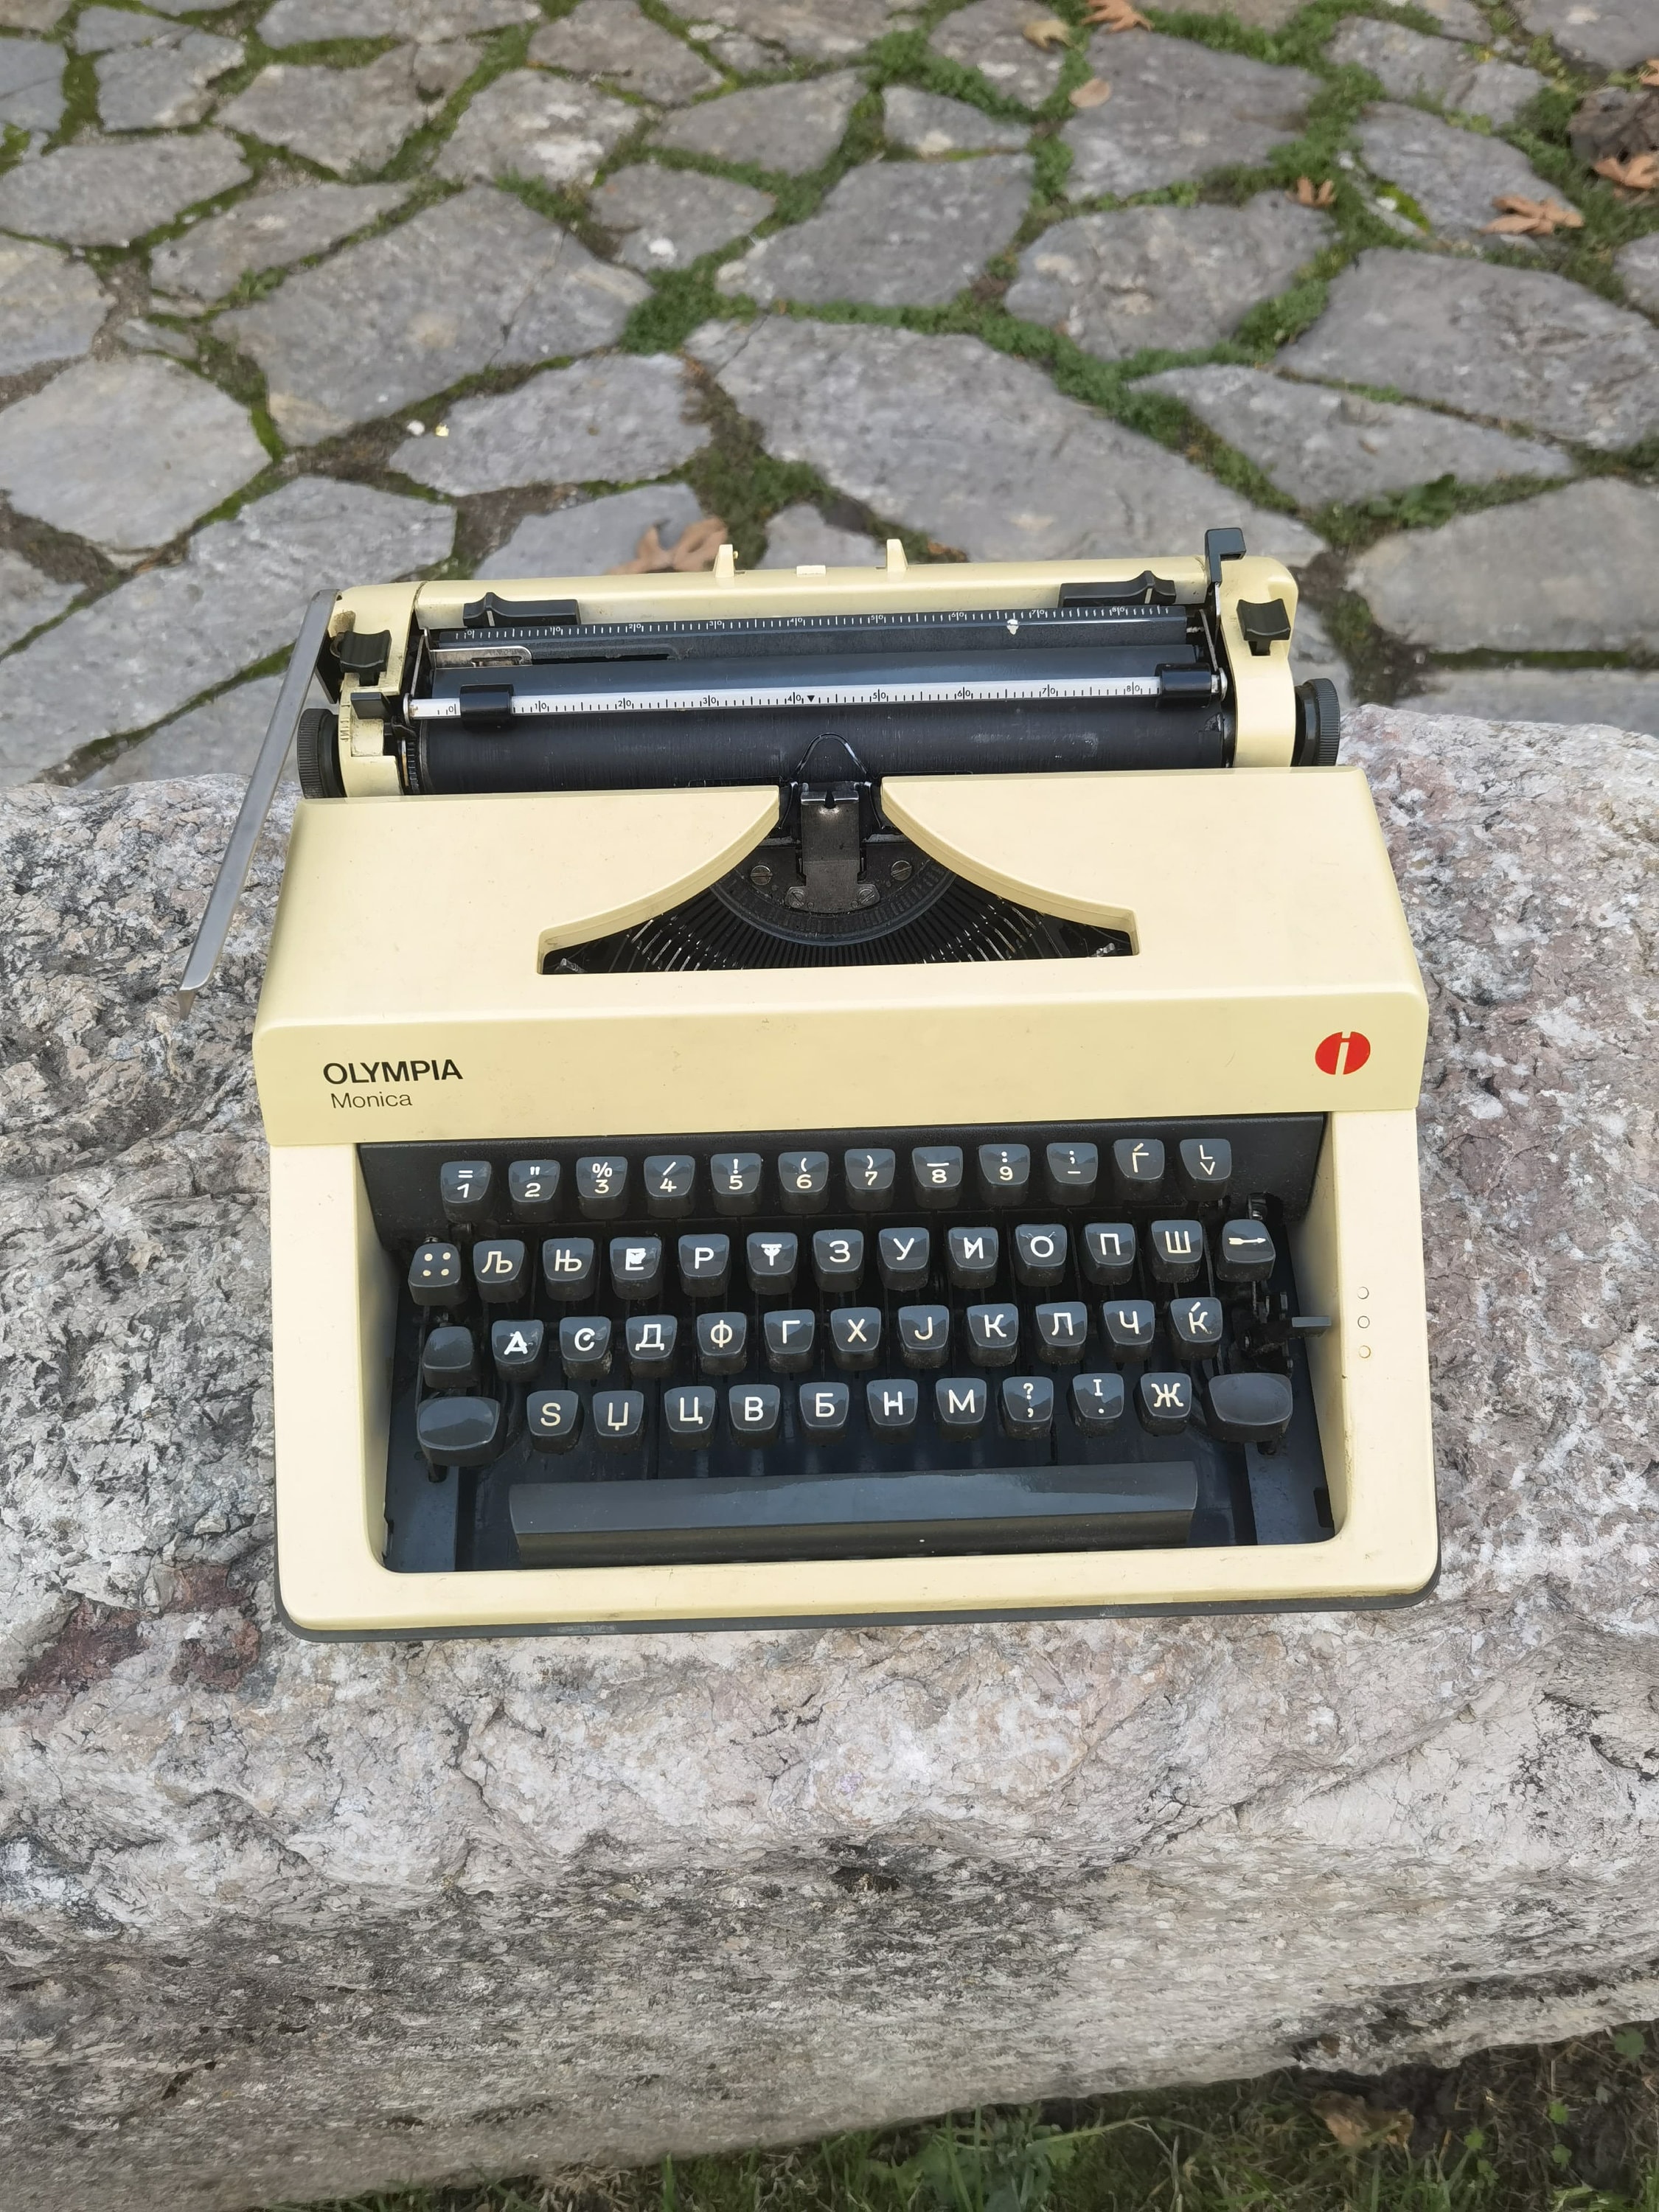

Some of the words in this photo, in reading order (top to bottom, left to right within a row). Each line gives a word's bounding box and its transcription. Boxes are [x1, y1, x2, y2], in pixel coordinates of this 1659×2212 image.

[703, 697, 717, 705] 30
[872, 692, 886, 700] 50
[957, 689, 971, 698] 60
[1041, 687, 1056, 695] 70
[1126, 684, 1140, 692] 80
[323, 1059, 463, 1085] OLYMPIA
[330, 1091, 413, 1108] Monica
[456, 1183, 470, 1198] 1
[524, 1182, 541, 1197] 2
[594, 1179, 610, 1194] 3
[659, 1178, 678, 1193] 4
[728, 1175, 743, 1190] 5
[796, 1173, 813, 1189] 6
[865, 1171, 878, 1186] 7
[931, 1169, 947, 1183] 8
[999, 1166, 1013, 1181] 9
[481, 1251, 513, 1273] Љ
[554, 1249, 582, 1272] Њ
[695, 1247, 714, 1270] Р
[829, 1239, 851, 1263] З
[893, 1237, 915, 1261] У
[963, 1237, 984, 1259] И
[1099, 1233, 1121, 1256] П
[1165, 1231, 1192, 1254] Ш
[504, 1331, 528, 1355] А
[574, 1327, 596, 1352] С
[635, 1324, 665, 1352] Д
[710, 1319, 733, 1348] Ф
[782, 1320, 801, 1344] Г
[847, 1318, 867, 1343] Х
[984, 1313, 1007, 1338] К
[1051, 1312, 1074, 1336] Л
[1119, 1310, 1140, 1335] Ч
[1188, 1301, 1208, 1334] Ќ
[608, 1402, 629, 1431] Џ
[679, 1397, 703, 1425] Ц
[744, 1396, 764, 1422] В
[815, 1392, 835, 1417] Б
[883, 1391, 903, 1416] Н
[948, 1388, 975, 1413] М
[1150, 1382, 1184, 1408] Ж
